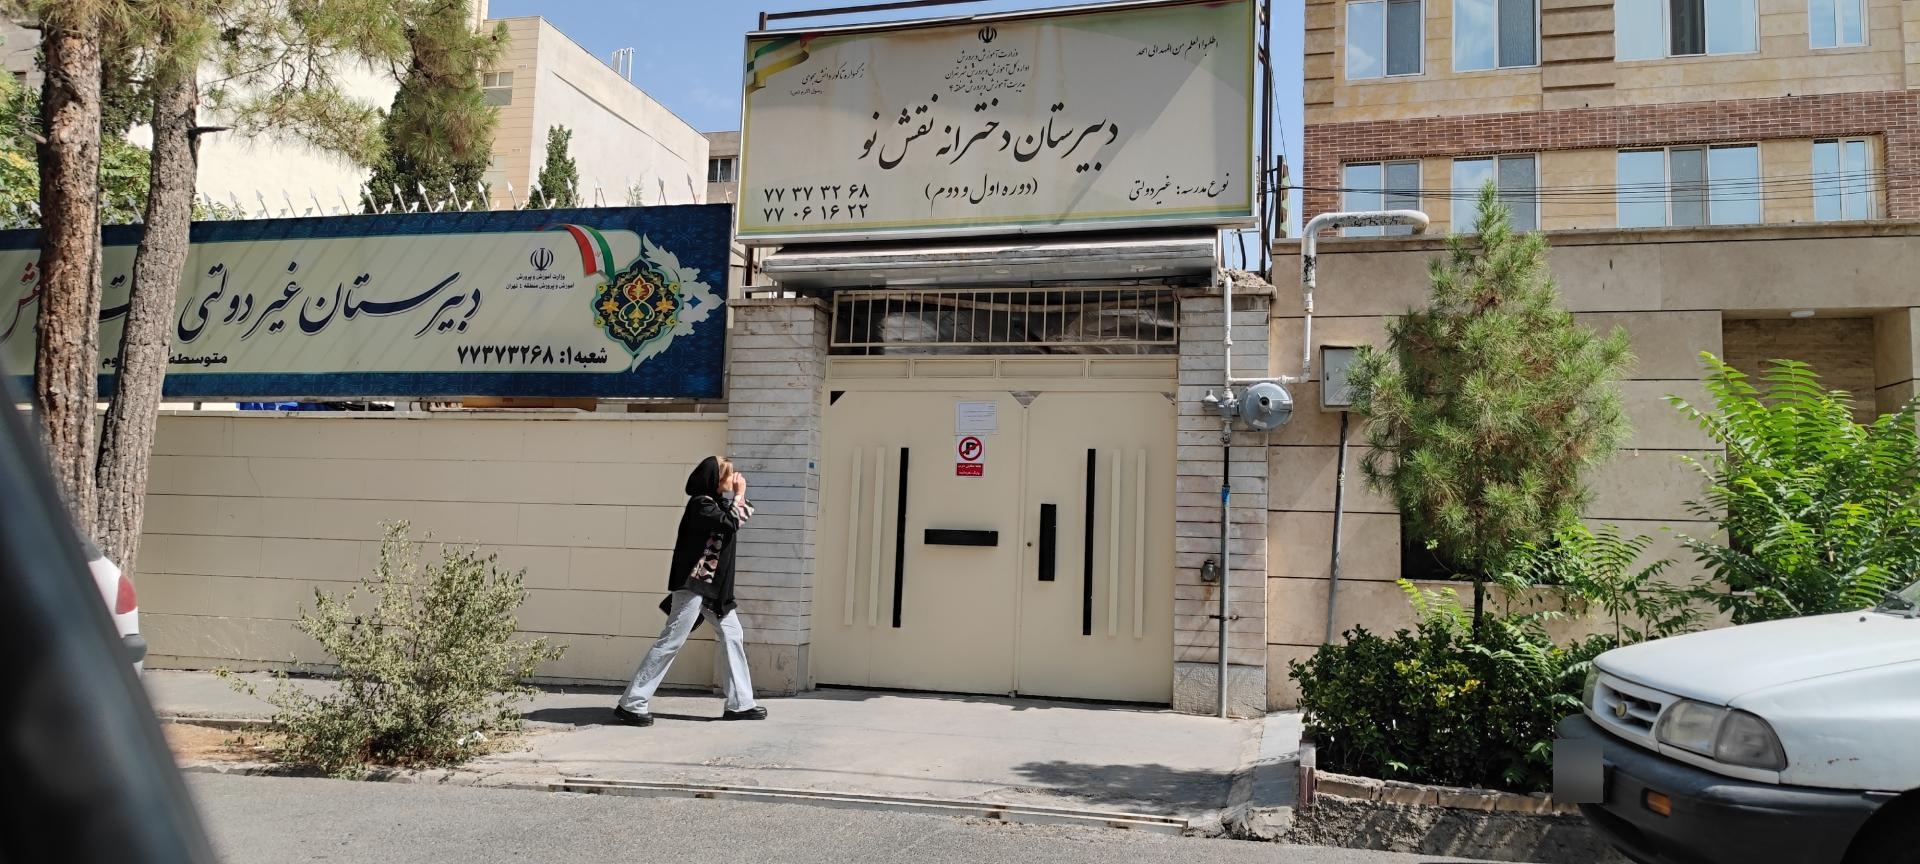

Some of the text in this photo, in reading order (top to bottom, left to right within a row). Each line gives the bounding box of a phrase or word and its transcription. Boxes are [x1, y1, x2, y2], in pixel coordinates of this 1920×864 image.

[978, 48, 1000, 61] آموزش
[998, 49, 1018, 58] وزارت
[1172, 43, 1185, 55] من
[957, 50, 975, 64] پرورش
[967, 63, 985, 78] پرورش
[988, 62, 1009, 76] آموزش
[953, 80, 966, 92] منطقه
[965, 80, 984, 95] پرورش
[986, 78, 1008, 91] آموزش
[1006, 80, 1026, 92] مدیریت
[858, 93, 1119, 174] دبیرستان دخترانه نقش نو
[1176, 185, 1207, 195] مدرسه:
[1207, 172, 1230, 198] نوع
[764, 183, 870, 203] ۷۷ ۳۷ ۳۲ ۶۸
[924, 173, 1039, 216] (دوره اول و دوم)
[763, 204, 868, 223] ۷۷ ۰۶ ۱۶ ۲۲
[552, 273, 565, 281] وزارت
[299, 271, 482, 339] دبیرستان
[168, 352, 228, 368] متوسطه
[457, 344, 554, 365] ۷۷۳۷۳۲۶۸
